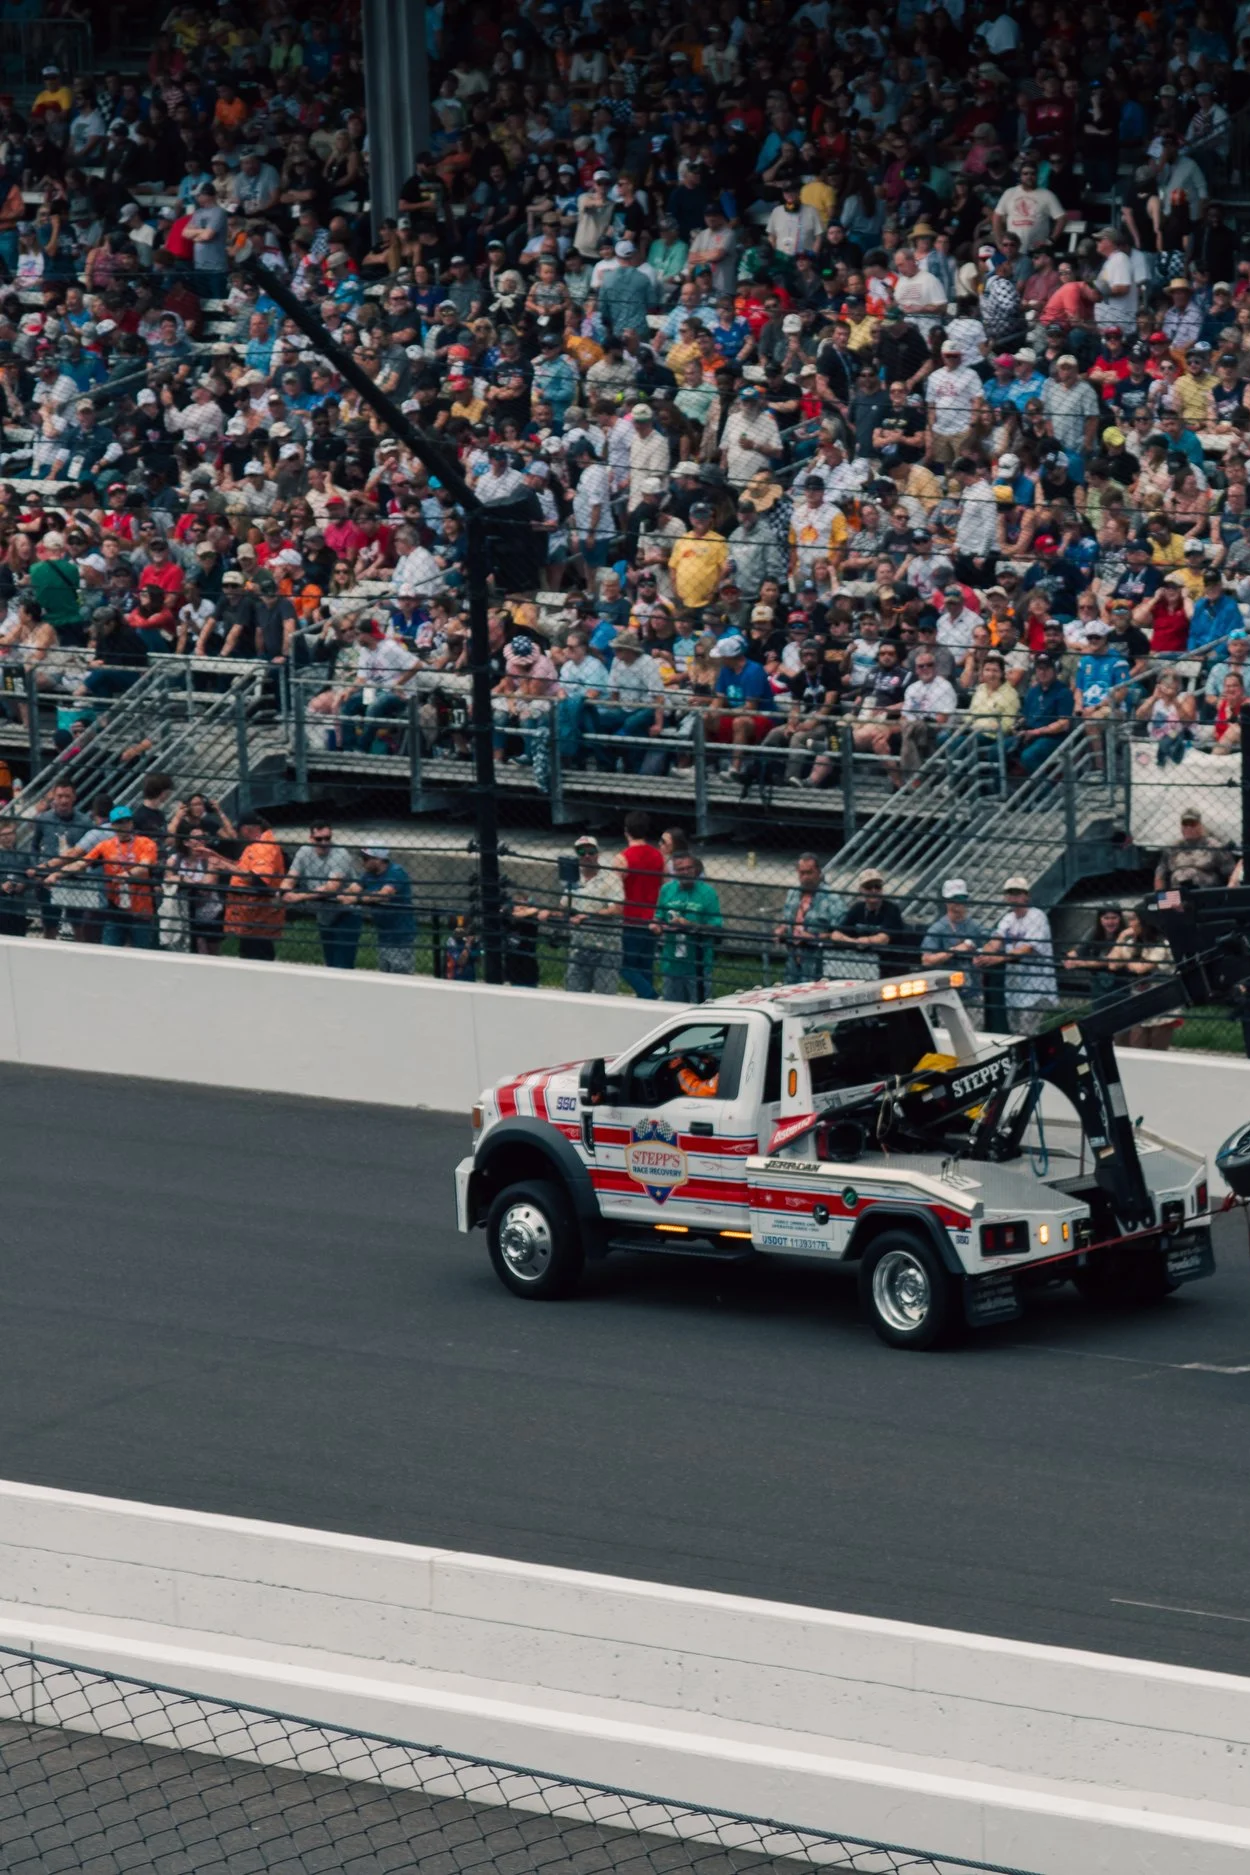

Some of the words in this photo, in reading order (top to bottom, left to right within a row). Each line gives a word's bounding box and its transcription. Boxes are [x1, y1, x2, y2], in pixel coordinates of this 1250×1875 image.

[952, 1057, 1012, 1098] STEPP'S
[632, 1150, 681, 1168] STEPP'S
[632, 1166, 649, 1175] RACE
[649, 1168, 682, 1177] RECOVERY
[762, 1235, 788, 1246] USDOT
